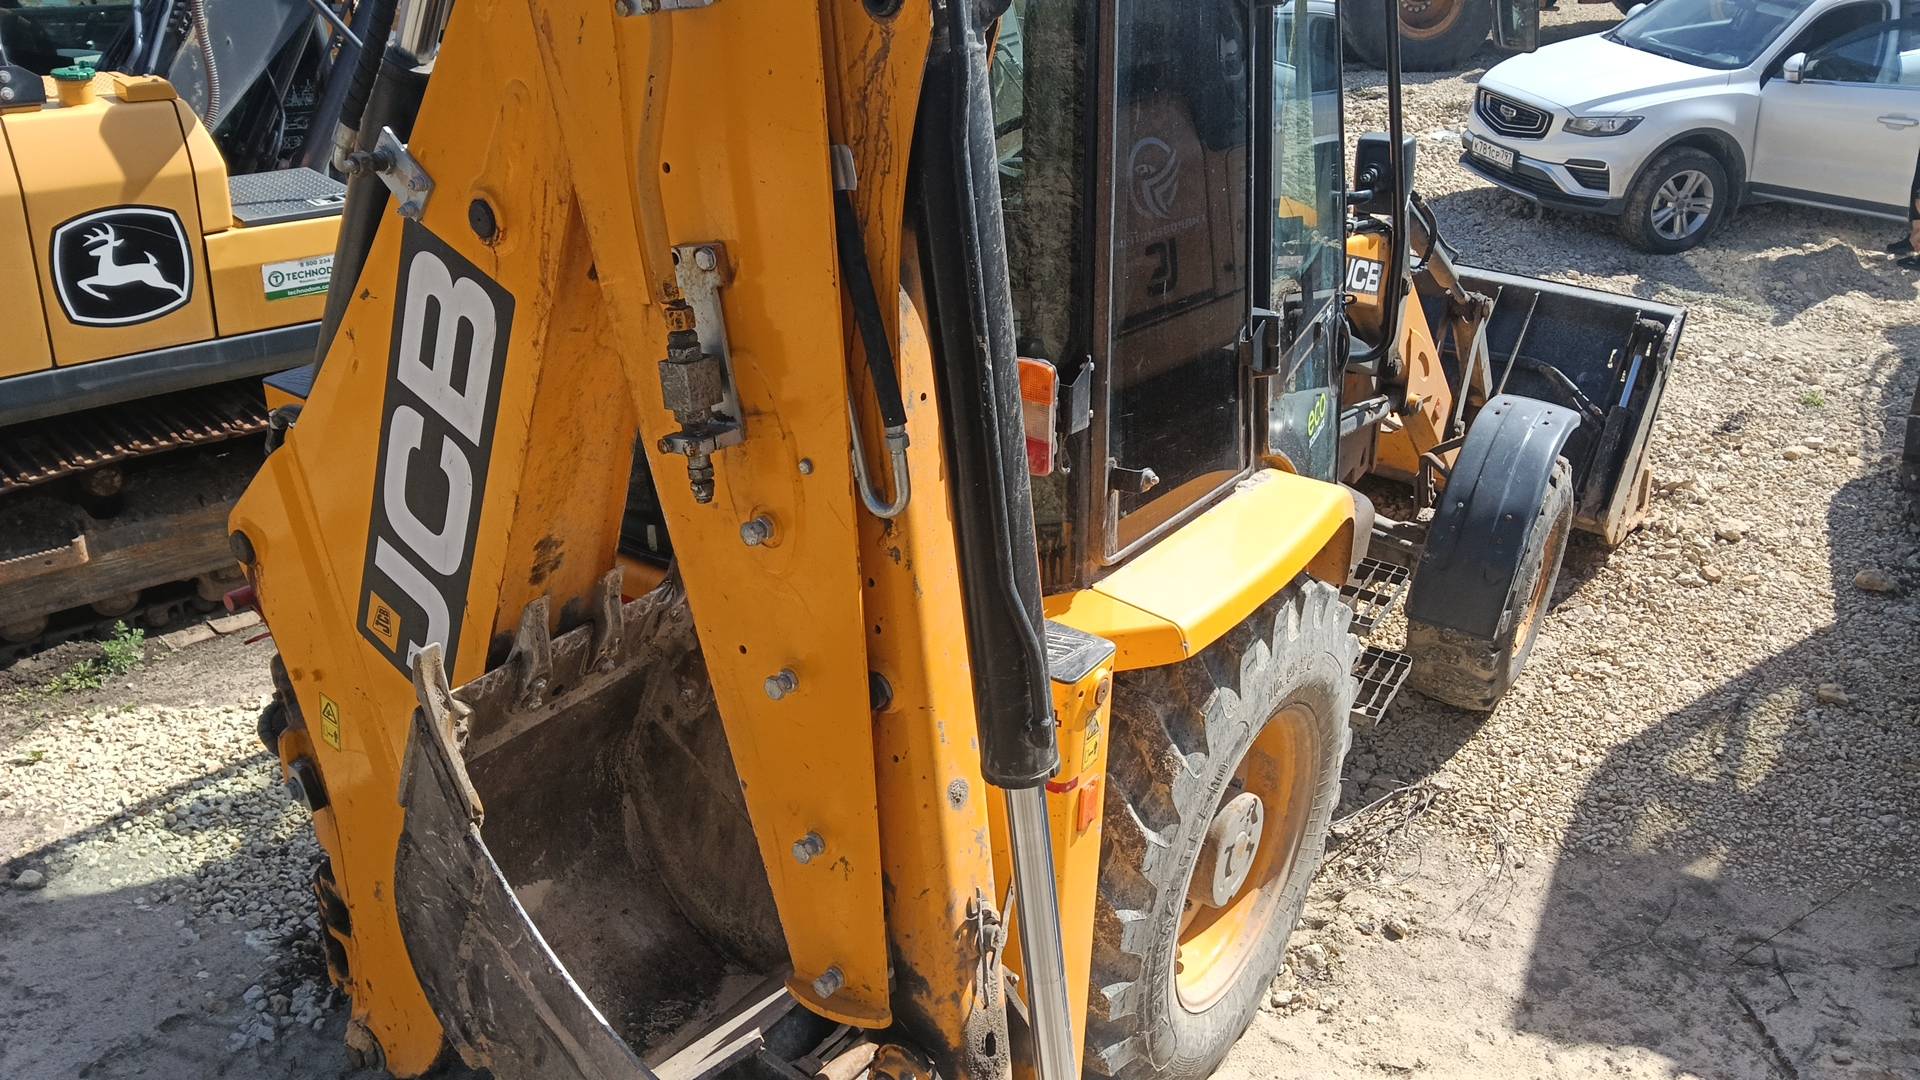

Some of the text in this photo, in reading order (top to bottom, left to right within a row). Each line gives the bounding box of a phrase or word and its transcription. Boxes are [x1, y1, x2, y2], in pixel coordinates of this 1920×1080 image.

[1308, 392, 1326, 437] eco
[374, 250, 497, 675] JCB
[374, 606, 391, 635] JCB
